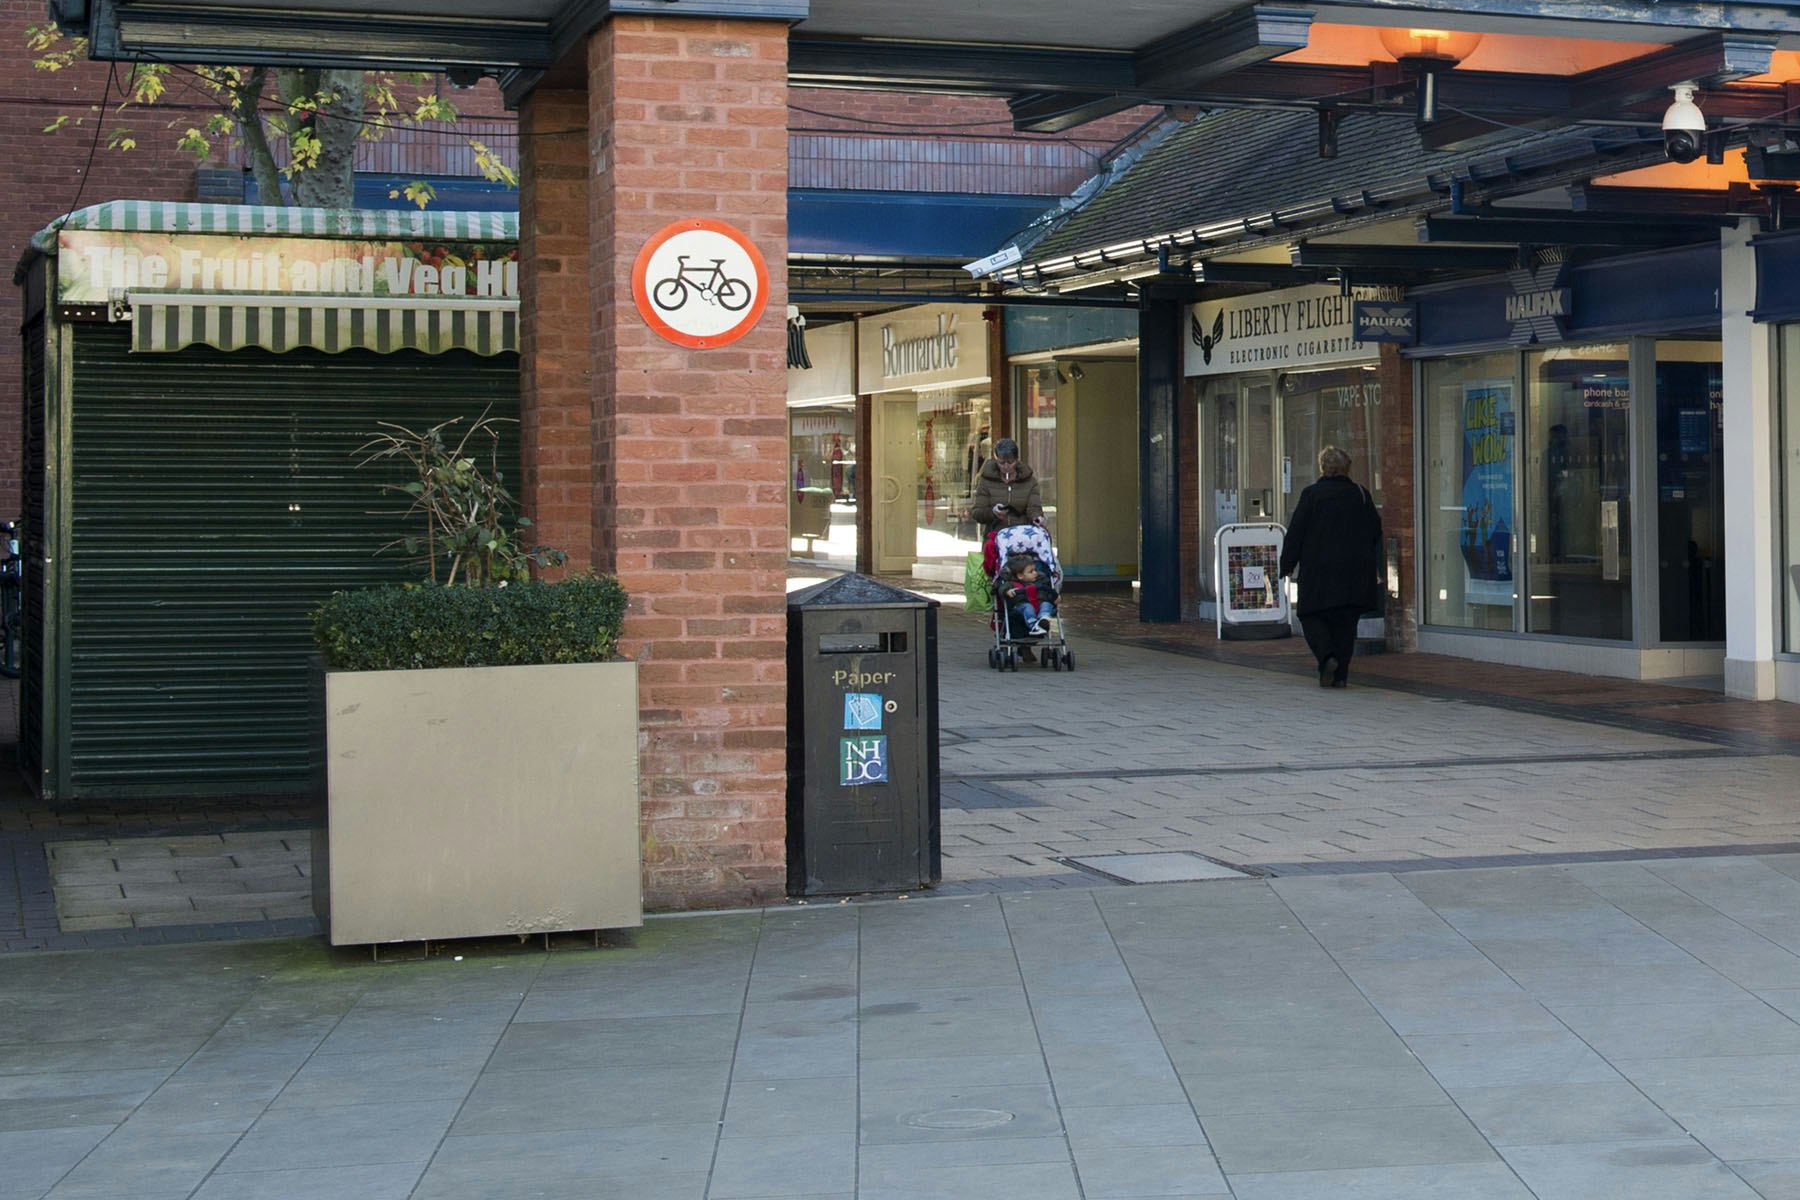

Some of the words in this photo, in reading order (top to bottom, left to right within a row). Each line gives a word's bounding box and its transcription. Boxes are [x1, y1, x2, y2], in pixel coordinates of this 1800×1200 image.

[84, 246, 169, 288] The
[179, 250, 282, 290] Fruit
[288, 255, 374, 293] and
[1505, 290, 1564, 321] HALIFAX
[1230, 302, 1292, 340] LIBERTY
[1360, 316, 1412, 328] HALIFAX
[881, 312, 958, 377] Bonmarché
[1230, 345, 1289, 364] ELECTRONIC
[1338, 384, 1360, 408] VAPE
[1584, 386, 1613, 399] phone
[1466, 394, 1497, 430] LIKE
[834, 669, 892, 688] Paper
[845, 740, 880, 760] NH
[845, 760, 882, 780] DC
